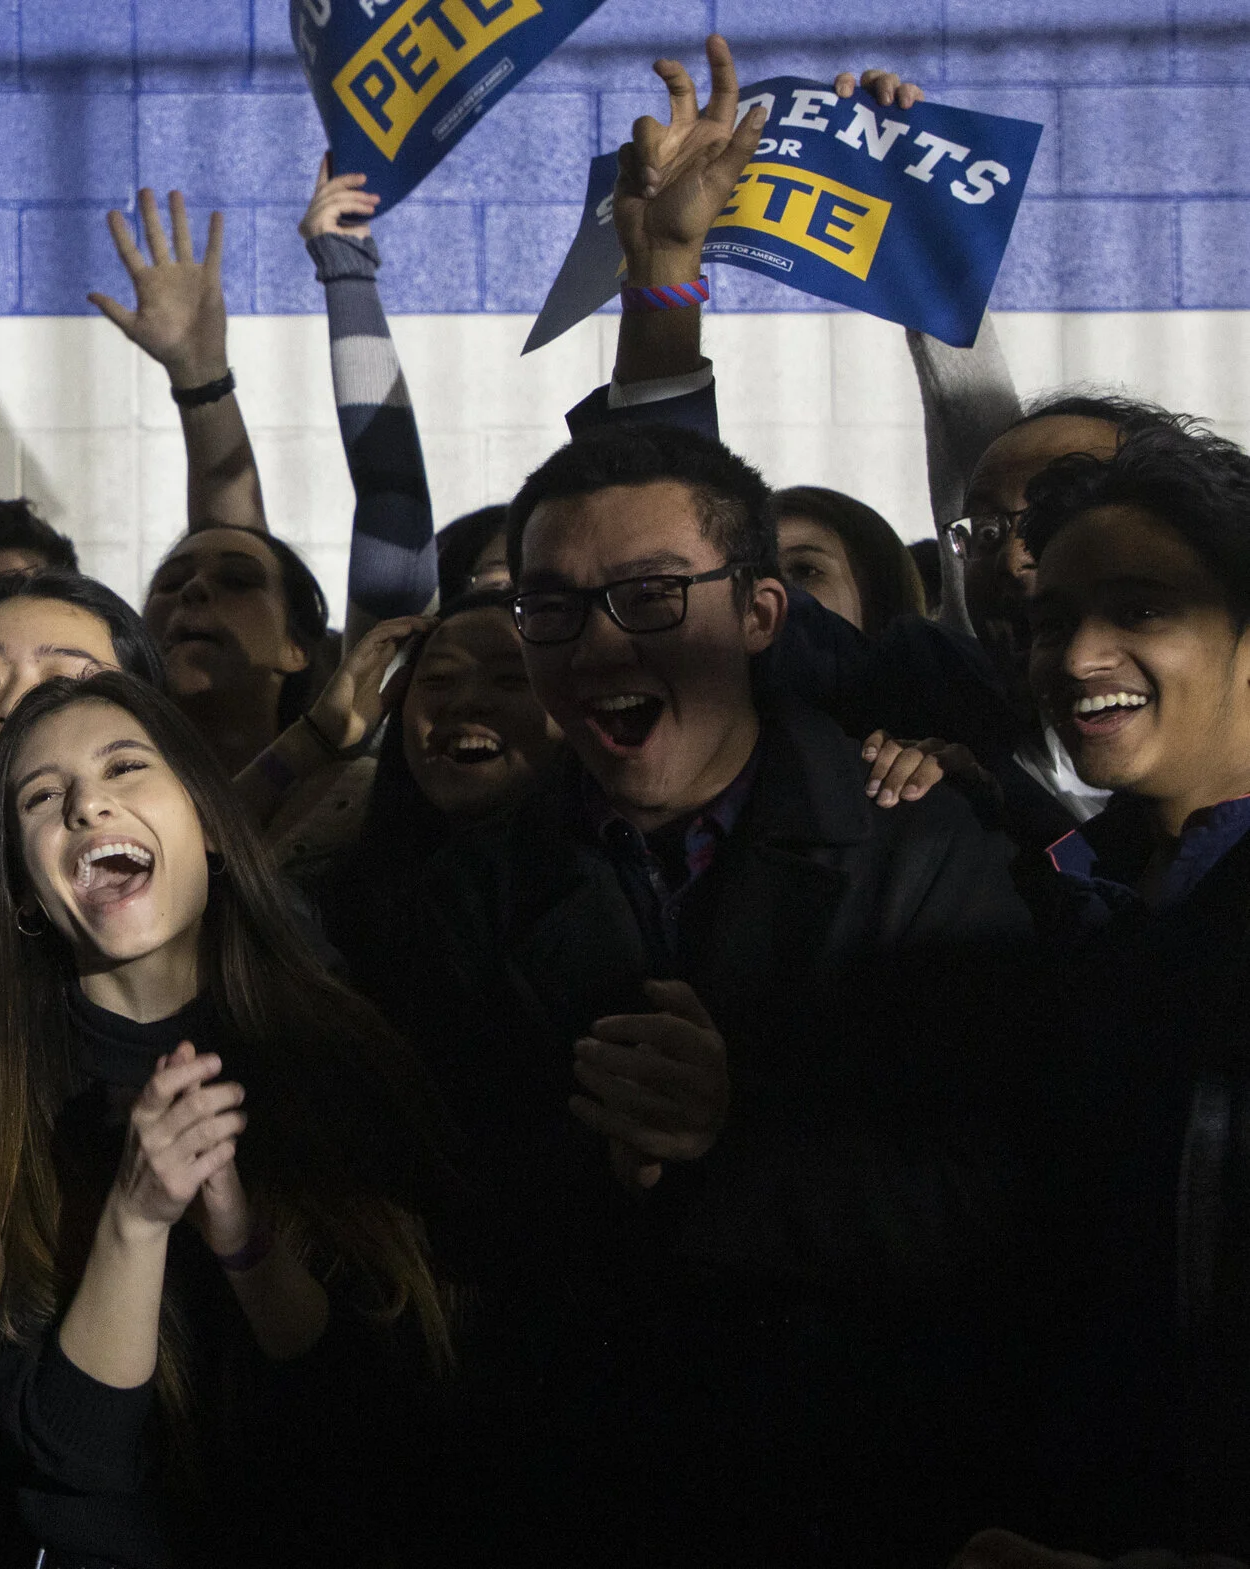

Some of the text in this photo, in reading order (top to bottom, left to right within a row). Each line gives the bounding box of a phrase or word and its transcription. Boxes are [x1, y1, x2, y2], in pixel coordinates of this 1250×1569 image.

[732, 88, 1011, 205] DENTS
[754, 138, 802, 158] OR
[718, 173, 869, 255] TE
[732, 246, 749, 254] FOR
[750, 249, 787, 267] AMERICA
